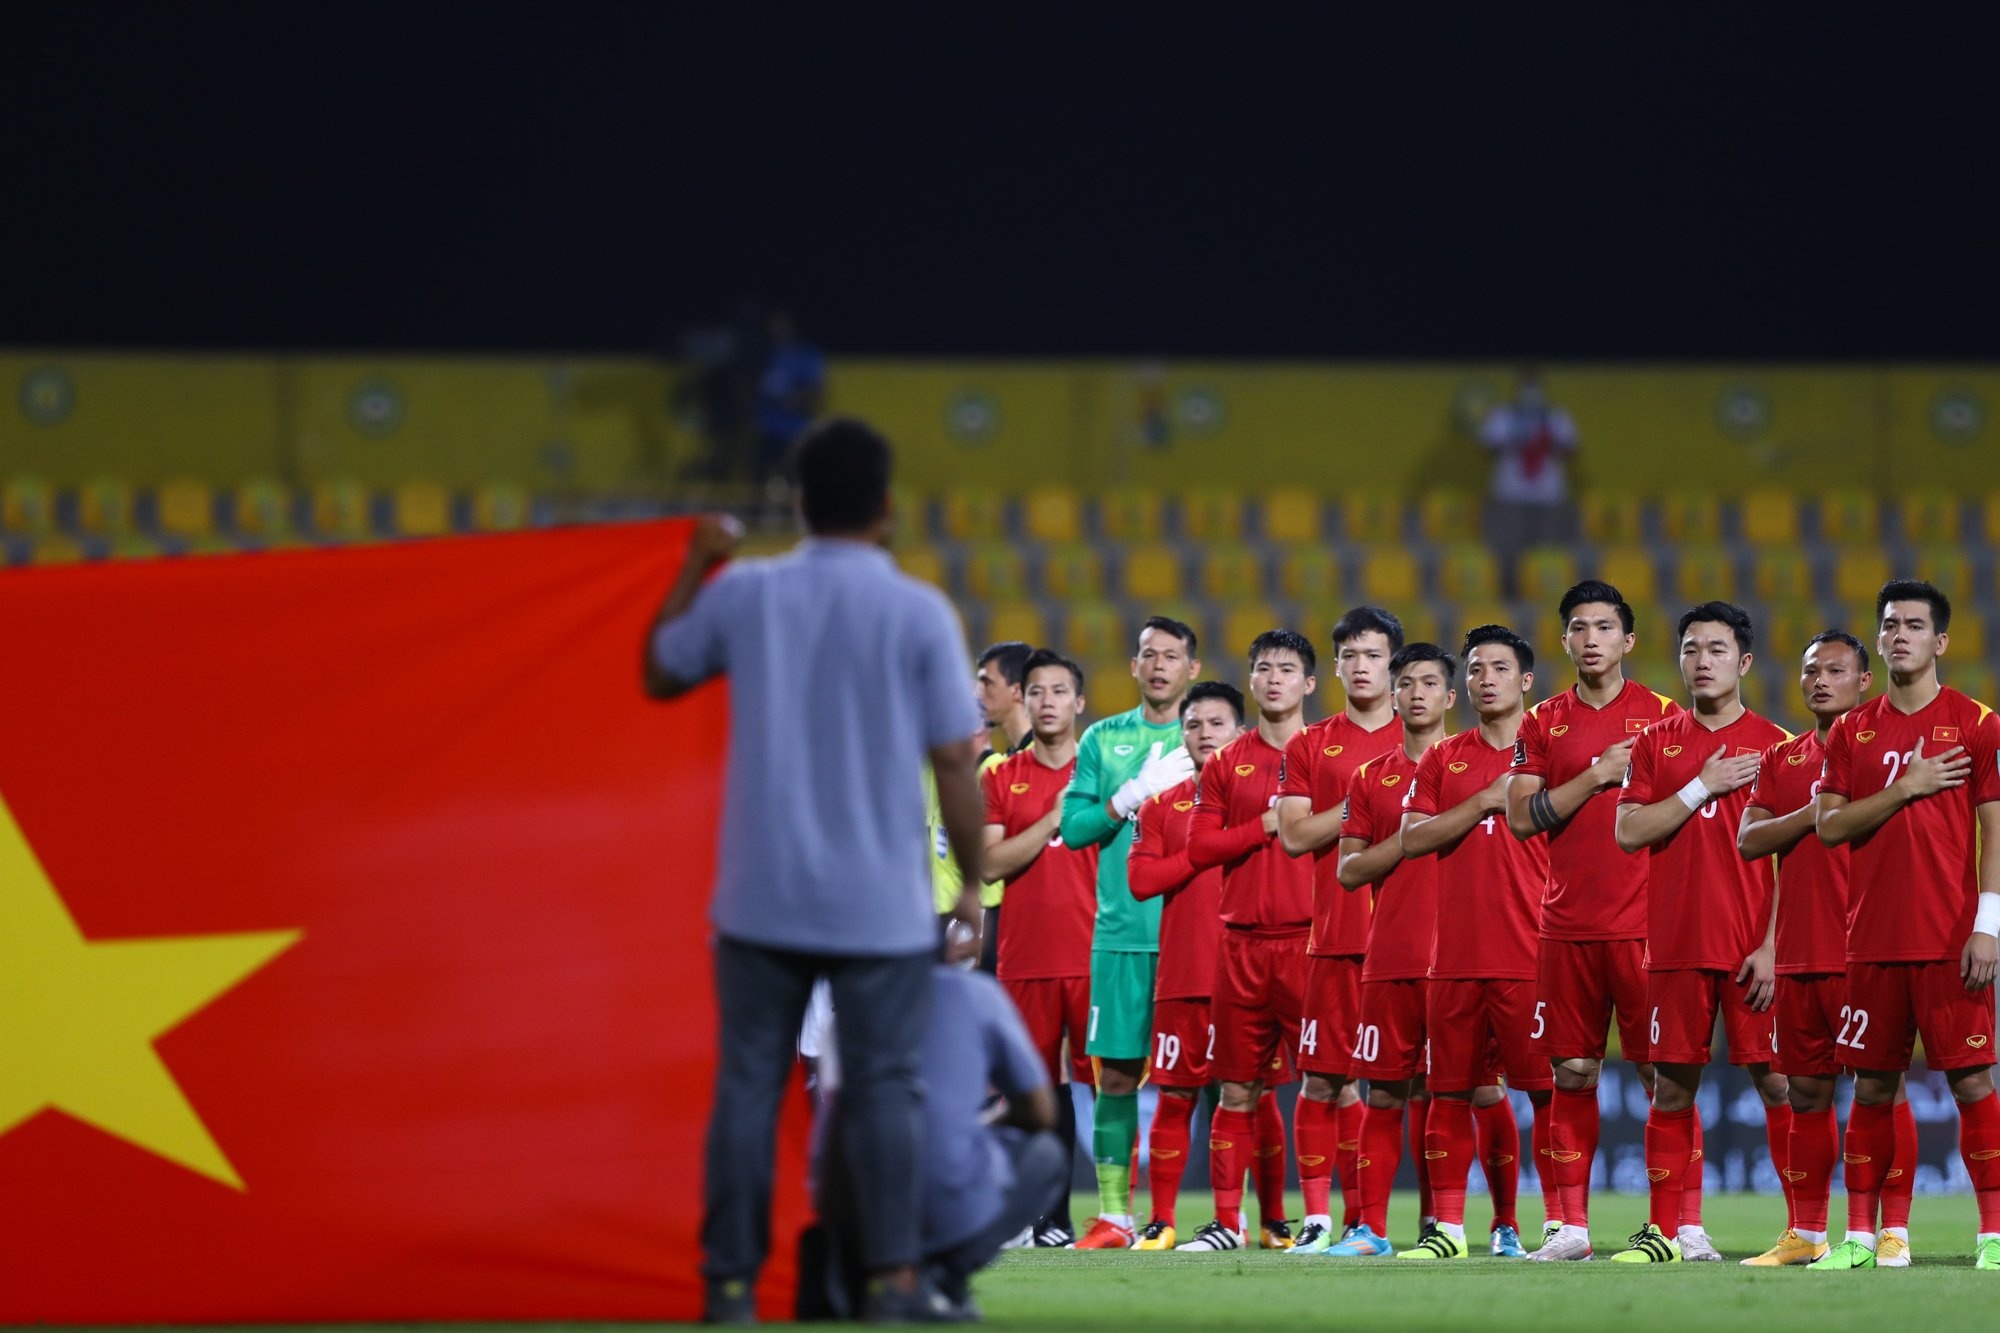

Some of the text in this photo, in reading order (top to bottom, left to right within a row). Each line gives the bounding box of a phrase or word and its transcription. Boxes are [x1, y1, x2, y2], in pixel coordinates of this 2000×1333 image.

[1883, 750, 1914, 789] 2
[1089, 1005, 1100, 1042] 1
[1298, 1017, 1318, 1056] 14
[1530, 1001, 1546, 1039] 5
[1650, 1006, 1660, 1045] 6
[1836, 1005, 1869, 1050] 22
[1155, 1031, 1180, 1071] 19
[1352, 1022, 1380, 1062] 20
